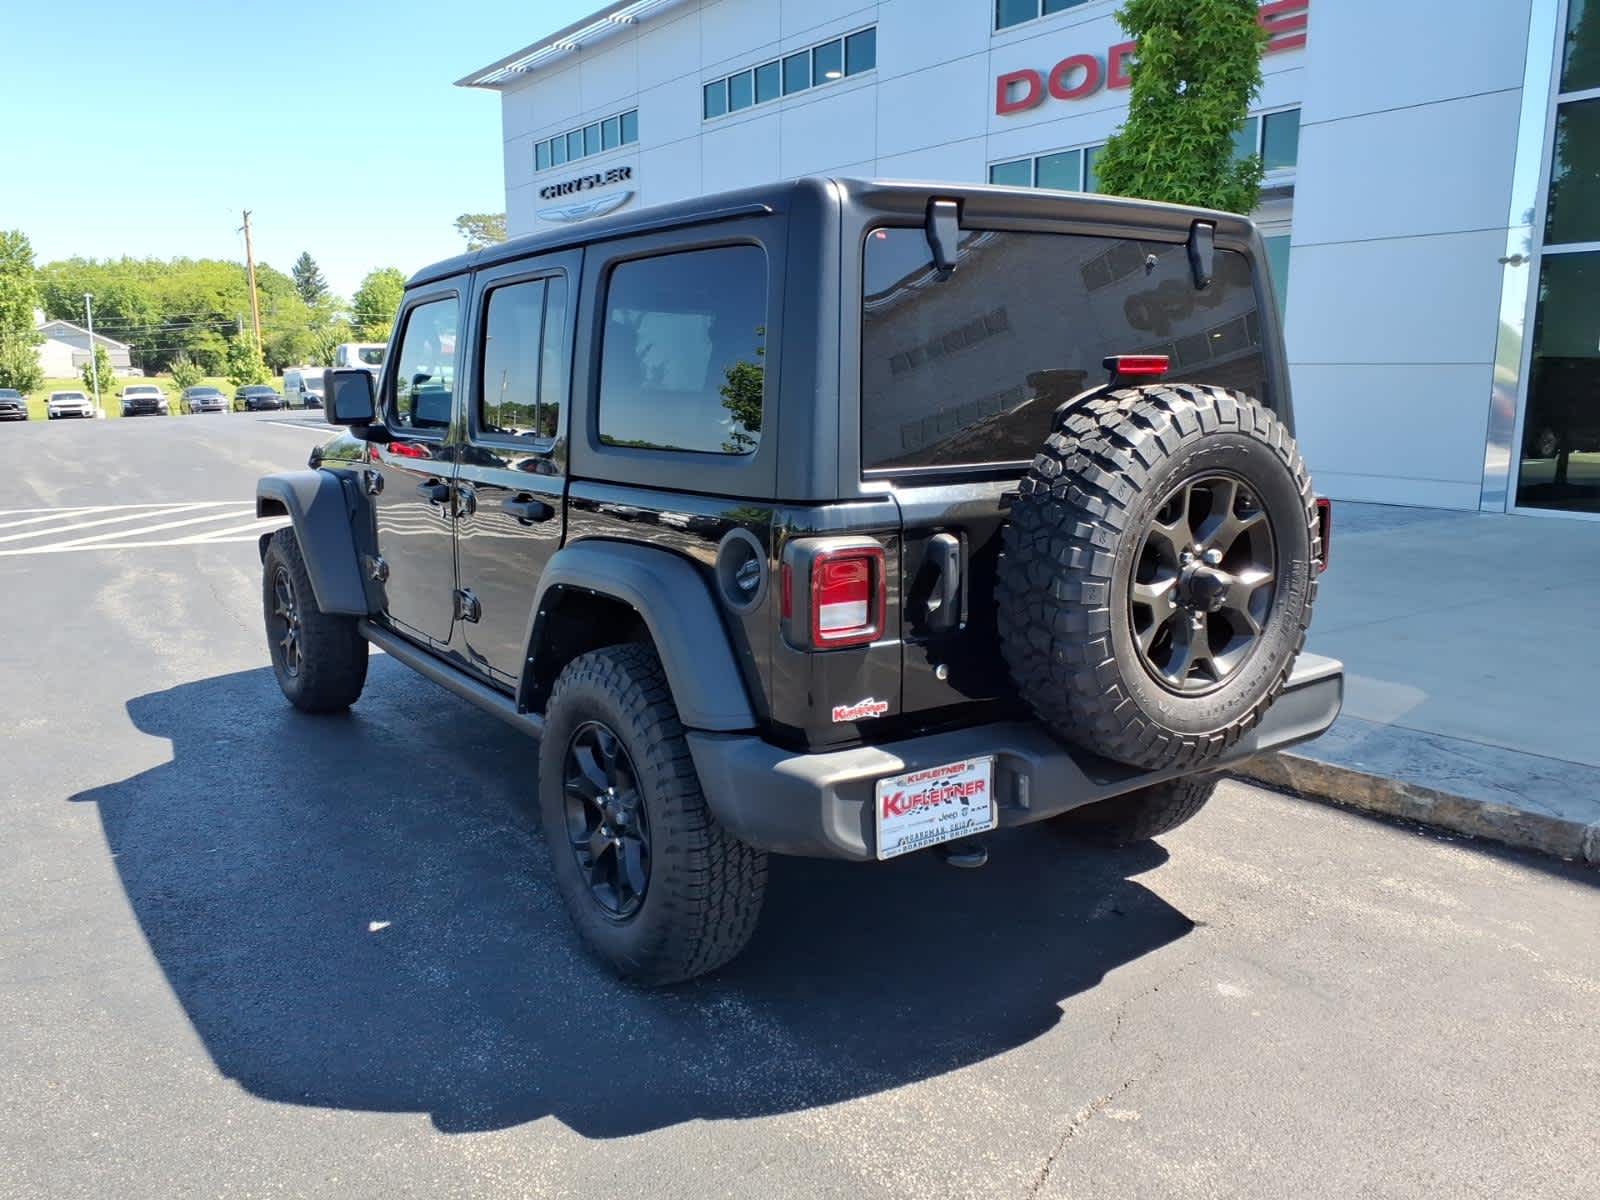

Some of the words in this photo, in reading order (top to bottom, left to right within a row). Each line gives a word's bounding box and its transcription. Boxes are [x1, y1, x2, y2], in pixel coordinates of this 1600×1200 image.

[996, 0, 1309, 115] DODE
[540, 166, 632, 199] CHRYSLER
[907, 763, 965, 783] KUFLEITNER
[883, 780, 985, 818] KUFLEITNER
[939, 811, 958, 821] Jeep
